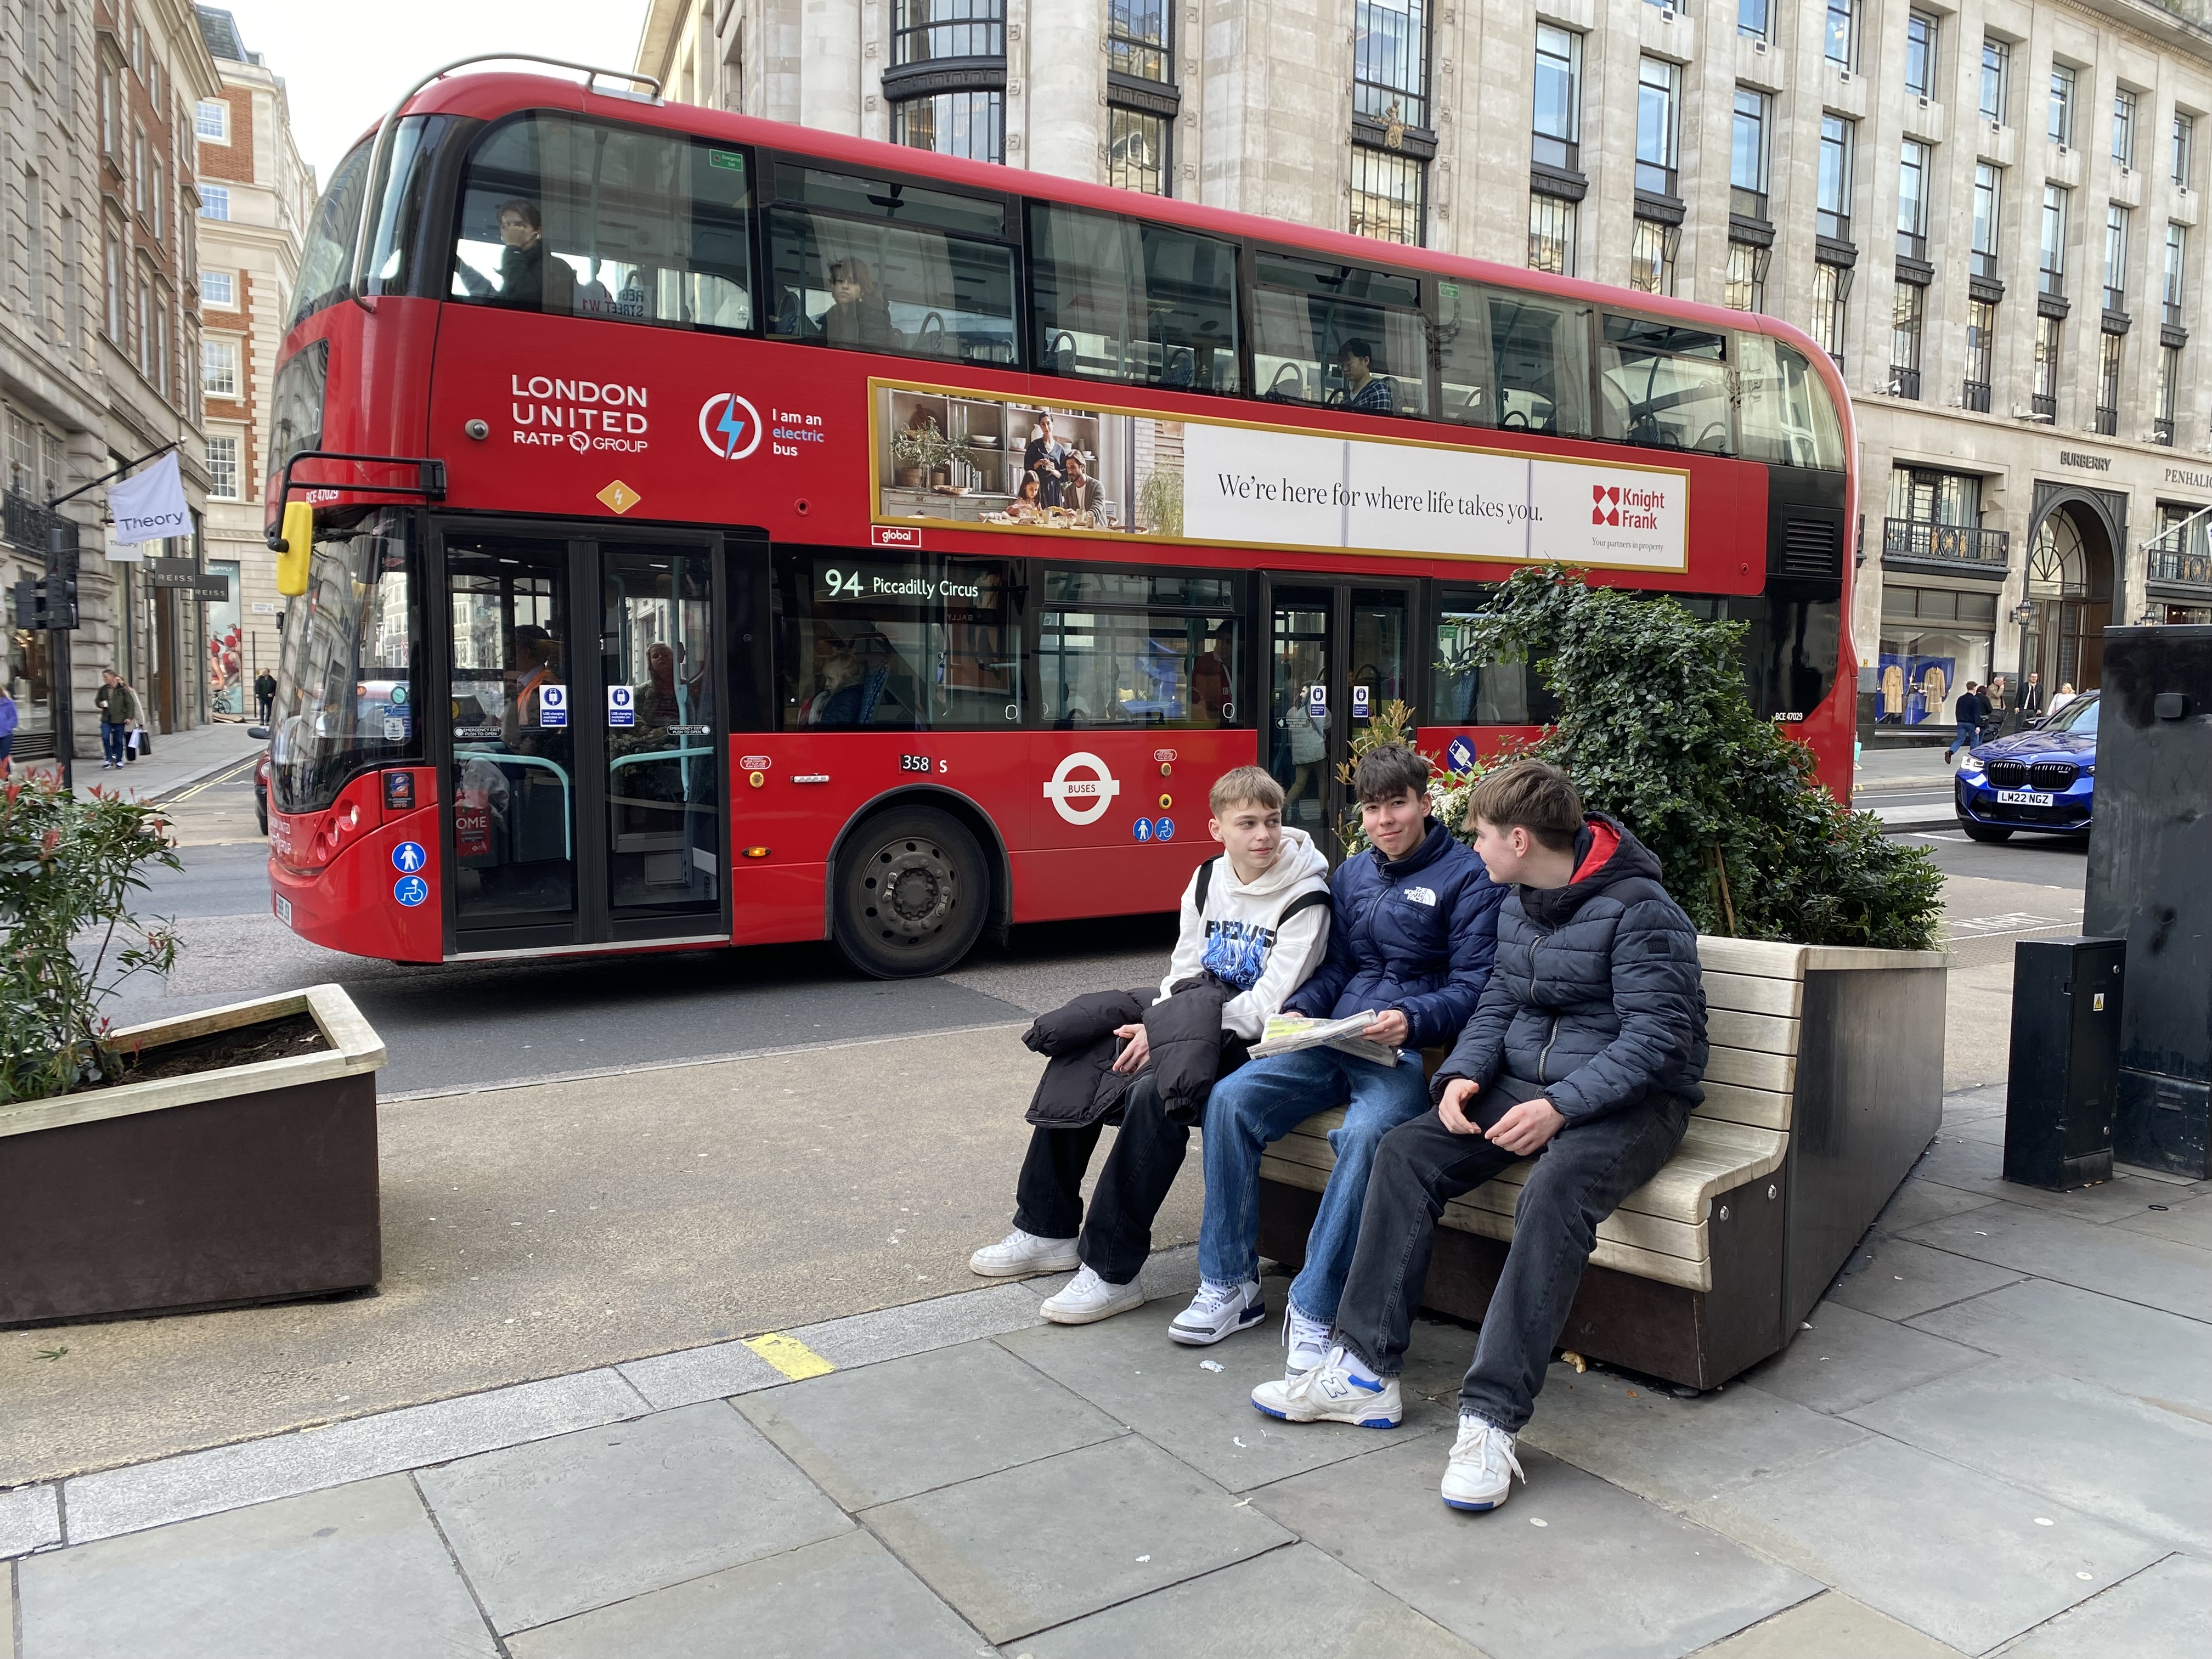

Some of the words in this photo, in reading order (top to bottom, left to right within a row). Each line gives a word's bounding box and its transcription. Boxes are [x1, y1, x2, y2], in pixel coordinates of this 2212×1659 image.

[512, 374, 646, 407] LONDON
[512, 403, 647, 433] UNITED
[772, 408, 776, 421] I
[781, 412, 802, 424] am
[805, 415, 822, 426] an
[513, 431, 563, 446] RATP
[592, 437, 647, 453] GROUP
[772, 426, 824, 442] electric
[773, 442, 798, 456] bus
[2060, 451, 2112, 471] BURBERRY
[1282, 478, 1327, 504] here
[1332, 482, 1361, 506] for
[1364, 486, 1423, 511] where
[1427, 490, 1454, 514] life
[1458, 494, 1504, 517] takes
[1507, 503, 1543, 524] you.
[1623, 488, 1664, 512] Knight
[119, 512, 183, 531] Theory
[1623, 510, 1658, 529] Frank
[882, 529, 911, 543] global
[1592, 537, 1606, 546] Your
[1607, 540, 1632, 549] partners
[1632, 540, 1638, 549] in
[1639, 542, 1664, 553] property
[825, 569, 864, 597] 94
[873, 577, 935, 599] Piccadilly
[939, 580, 979, 597] Circus
[1775, 712, 1786, 720] BCE
[1786, 712, 1803, 720] 47029
[902, 755, 929, 771] 358
[939, 759, 947, 773] S
[1068, 785, 1096, 793] BUSES
[2002, 792, 2026, 803] LM22
[2029, 794, 2049, 804] NGZ
[1404, 889, 1424, 898] NORTH
[1407, 895, 1424, 903] FACE
